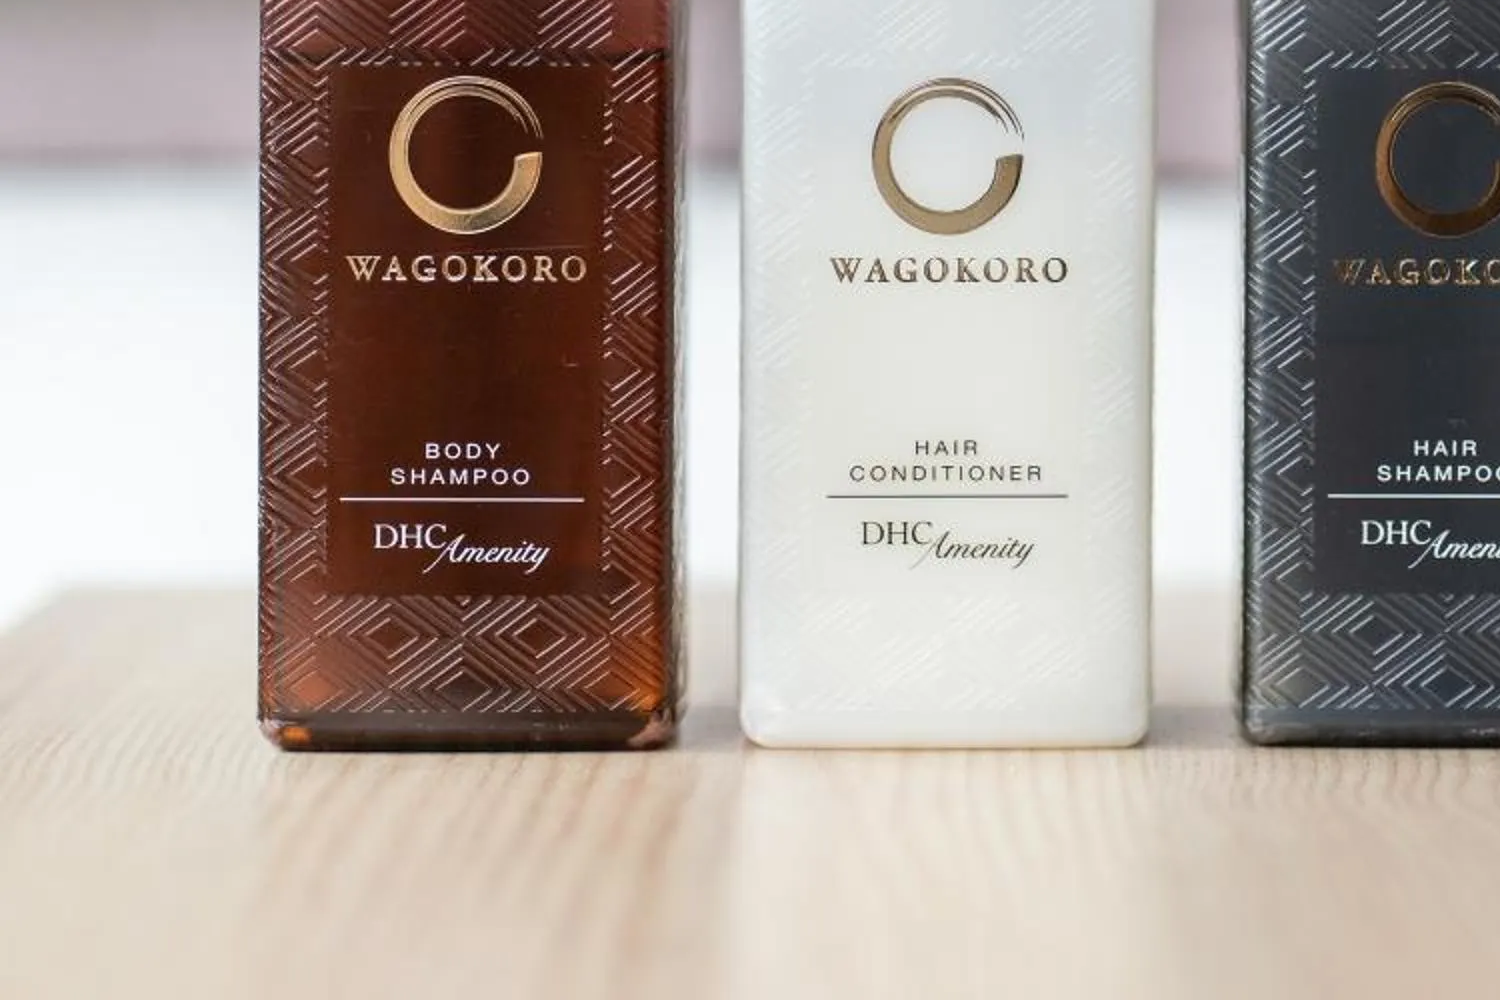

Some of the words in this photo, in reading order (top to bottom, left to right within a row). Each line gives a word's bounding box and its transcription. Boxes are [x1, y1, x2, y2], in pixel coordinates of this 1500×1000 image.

[345, 254, 588, 283] WAGOKORO
[829, 256, 1069, 284] WAGOKORO
[424, 443, 501, 460] BODY
[914, 439, 979, 457] HAIR
[1413, 439, 1478, 457] HAIR
[389, 468, 531, 486] SHAMPOO
[849, 464, 1043, 482] CONDITIONER
[1360, 520, 1432, 546] DHC
[374, 523, 447, 550] DHC
[422, 533, 550, 575] Amenity
[861, 520, 933, 547] DHC
[908, 530, 1034, 571] Amenity
